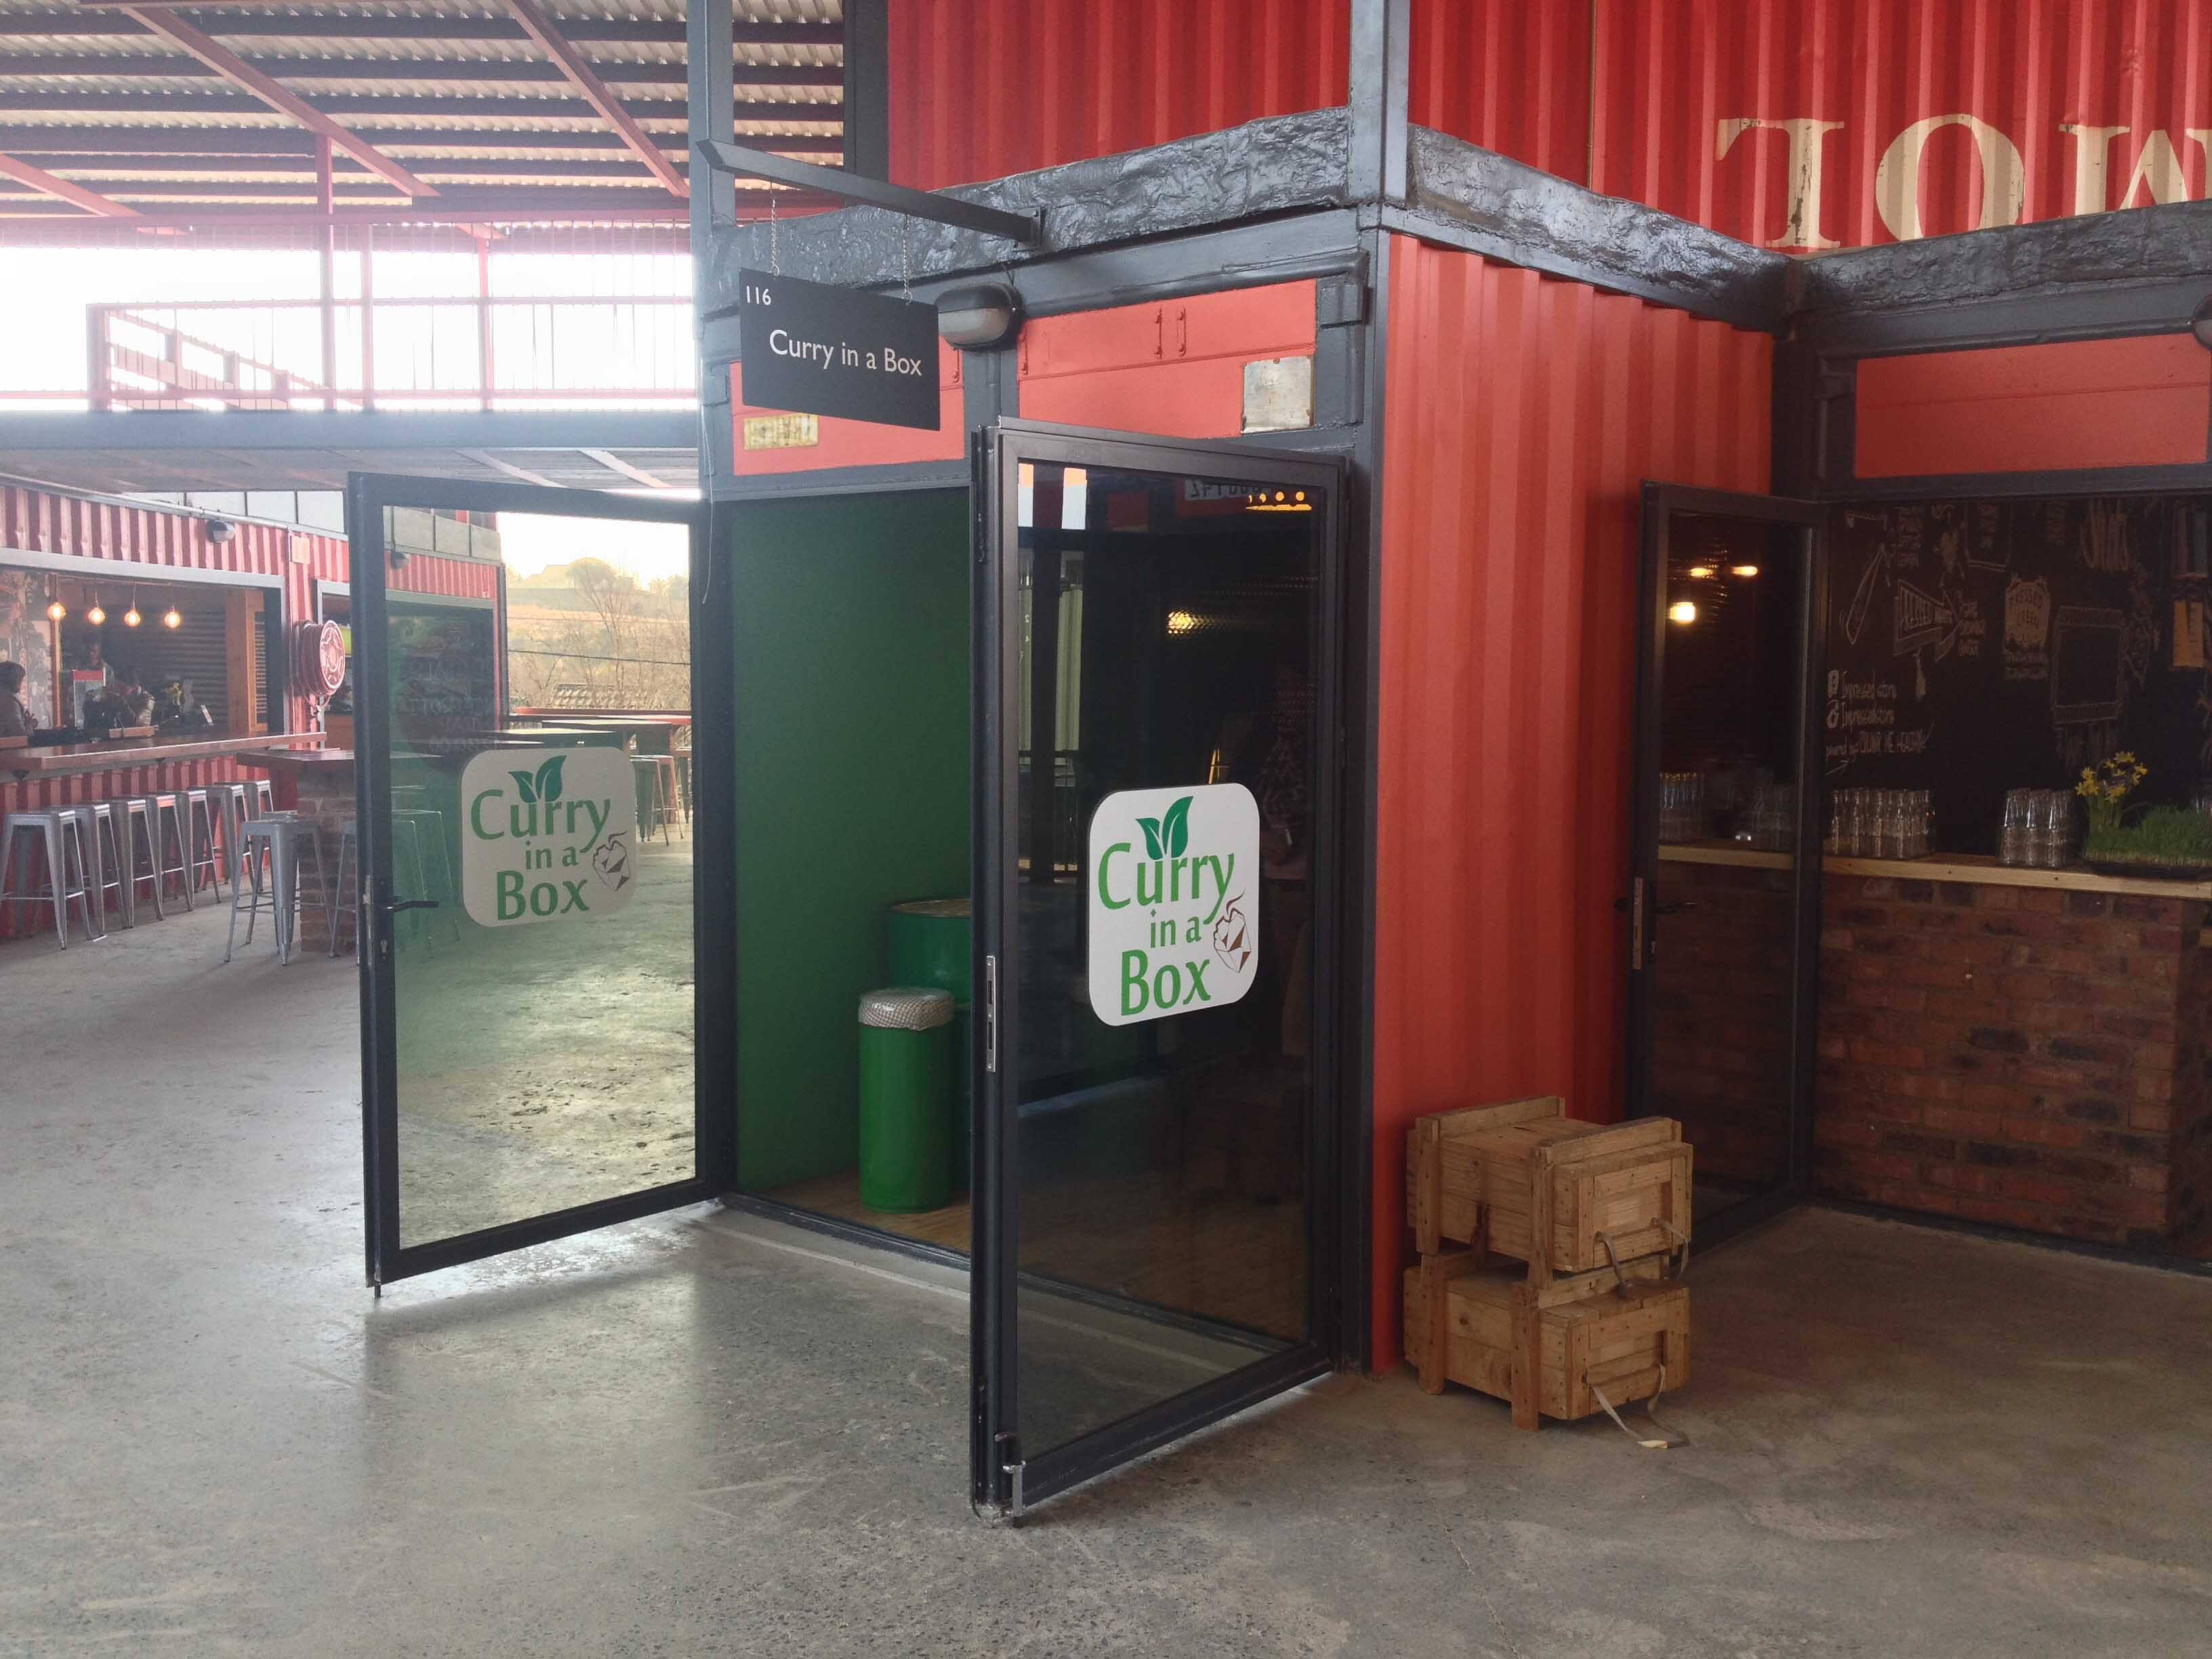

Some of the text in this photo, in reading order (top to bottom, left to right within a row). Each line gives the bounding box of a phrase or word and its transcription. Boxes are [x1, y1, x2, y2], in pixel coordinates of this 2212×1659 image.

[745, 285, 771, 306] 116
[769, 329, 922, 376] Curry in a Box
[470, 789, 610, 854] Curry
[525, 840, 579, 870] in a
[496, 869, 590, 921] Box
[1098, 842, 1235, 925] Curry
[1150, 909, 1202, 949] in a
[1120, 949, 1211, 1017] Box
